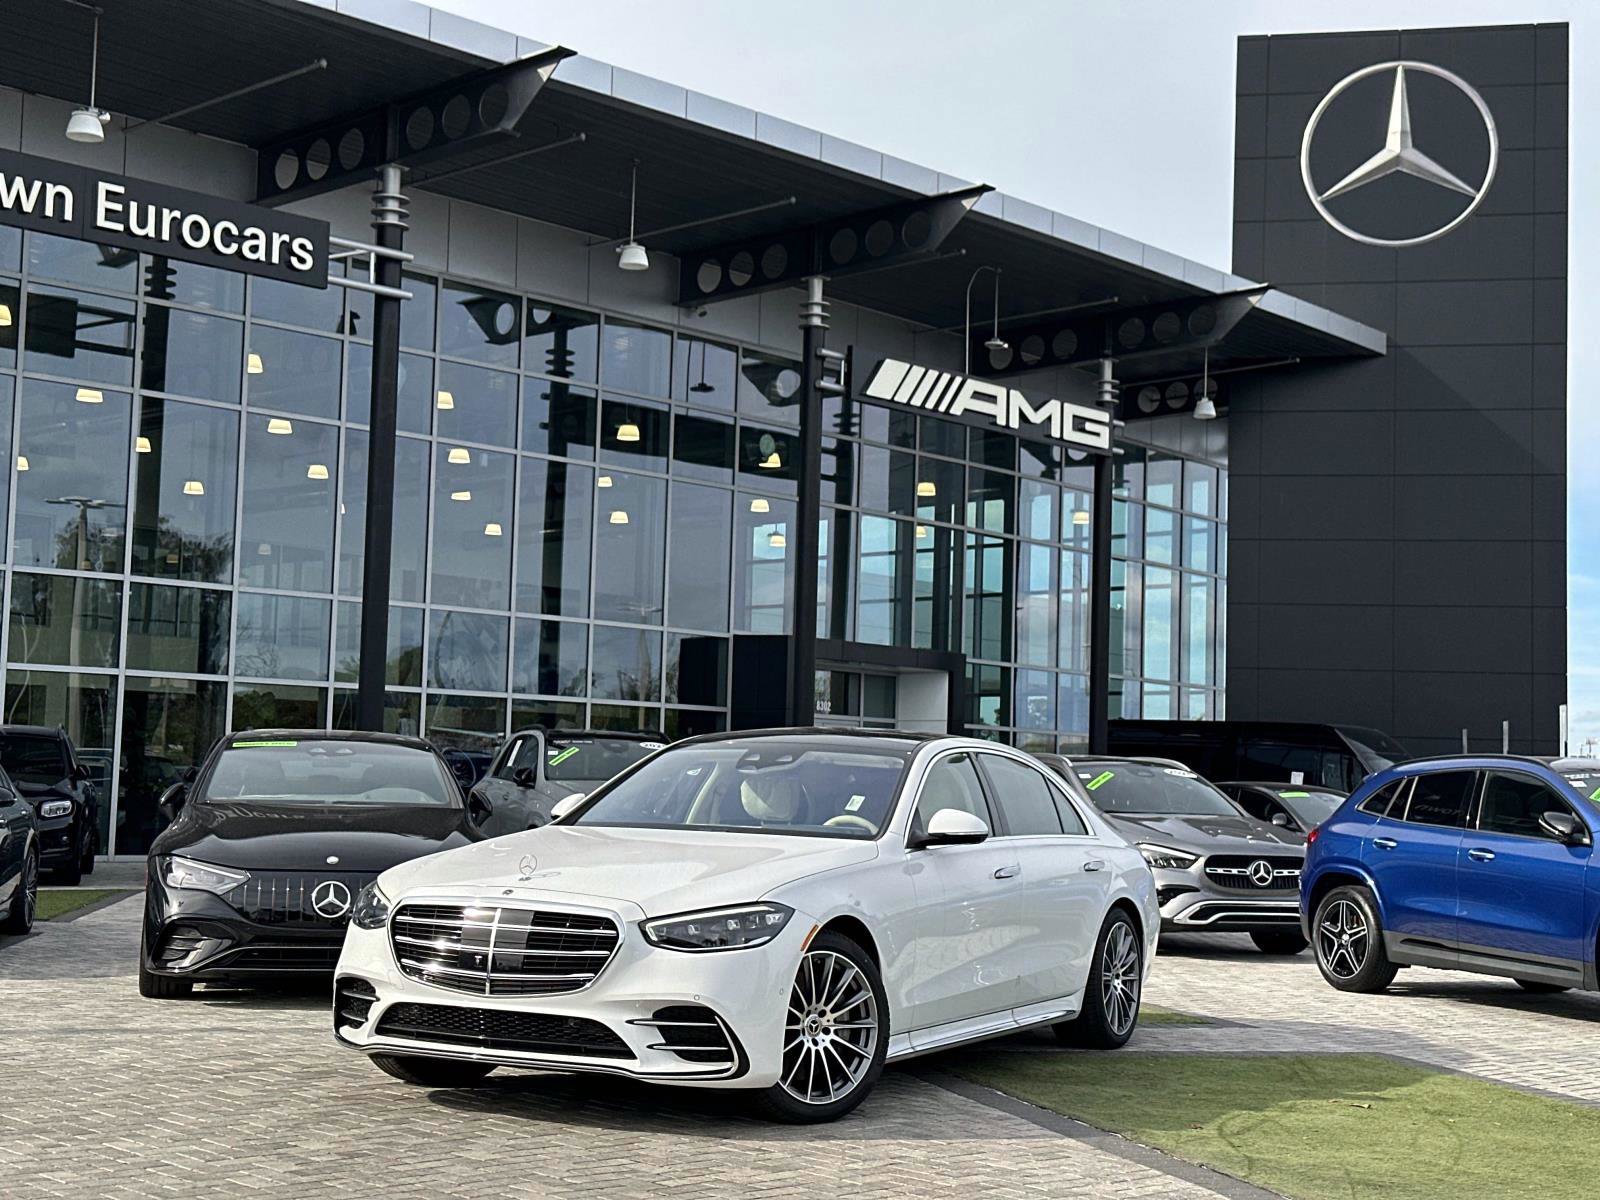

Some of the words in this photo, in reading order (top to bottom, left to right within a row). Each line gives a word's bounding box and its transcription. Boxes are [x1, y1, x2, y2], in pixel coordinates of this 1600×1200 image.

[0, 172, 73, 221] wn
[97, 181, 315, 271] Eurocars
[949, 378, 1110, 450] AMG
